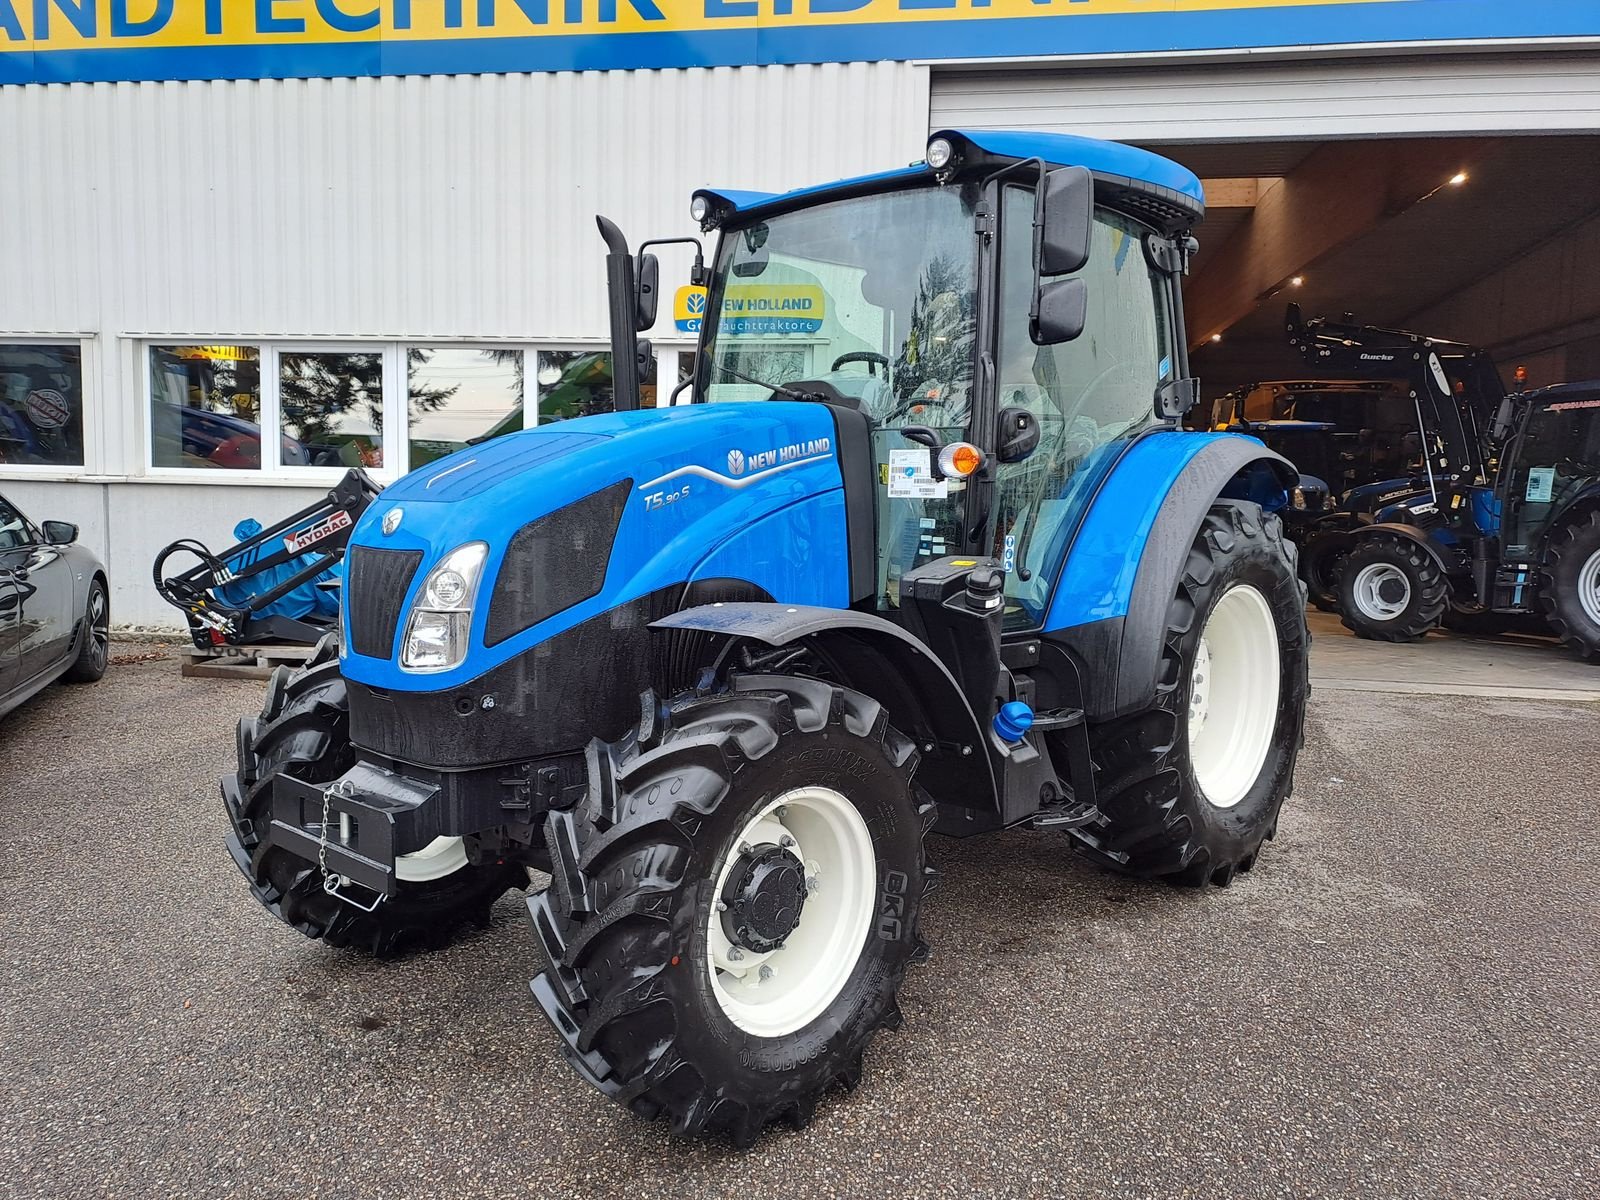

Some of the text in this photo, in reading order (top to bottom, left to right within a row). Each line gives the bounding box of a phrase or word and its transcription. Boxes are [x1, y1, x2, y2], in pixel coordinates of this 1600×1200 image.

[722, 298, 812, 310] EW HOLLAND
[687, 319, 813, 331] Gauchttraktore
[748, 437, 830, 472] NEW HOLLAND
[297, 517, 348, 549] HYDRAC
[878, 871, 908, 941] BKT
